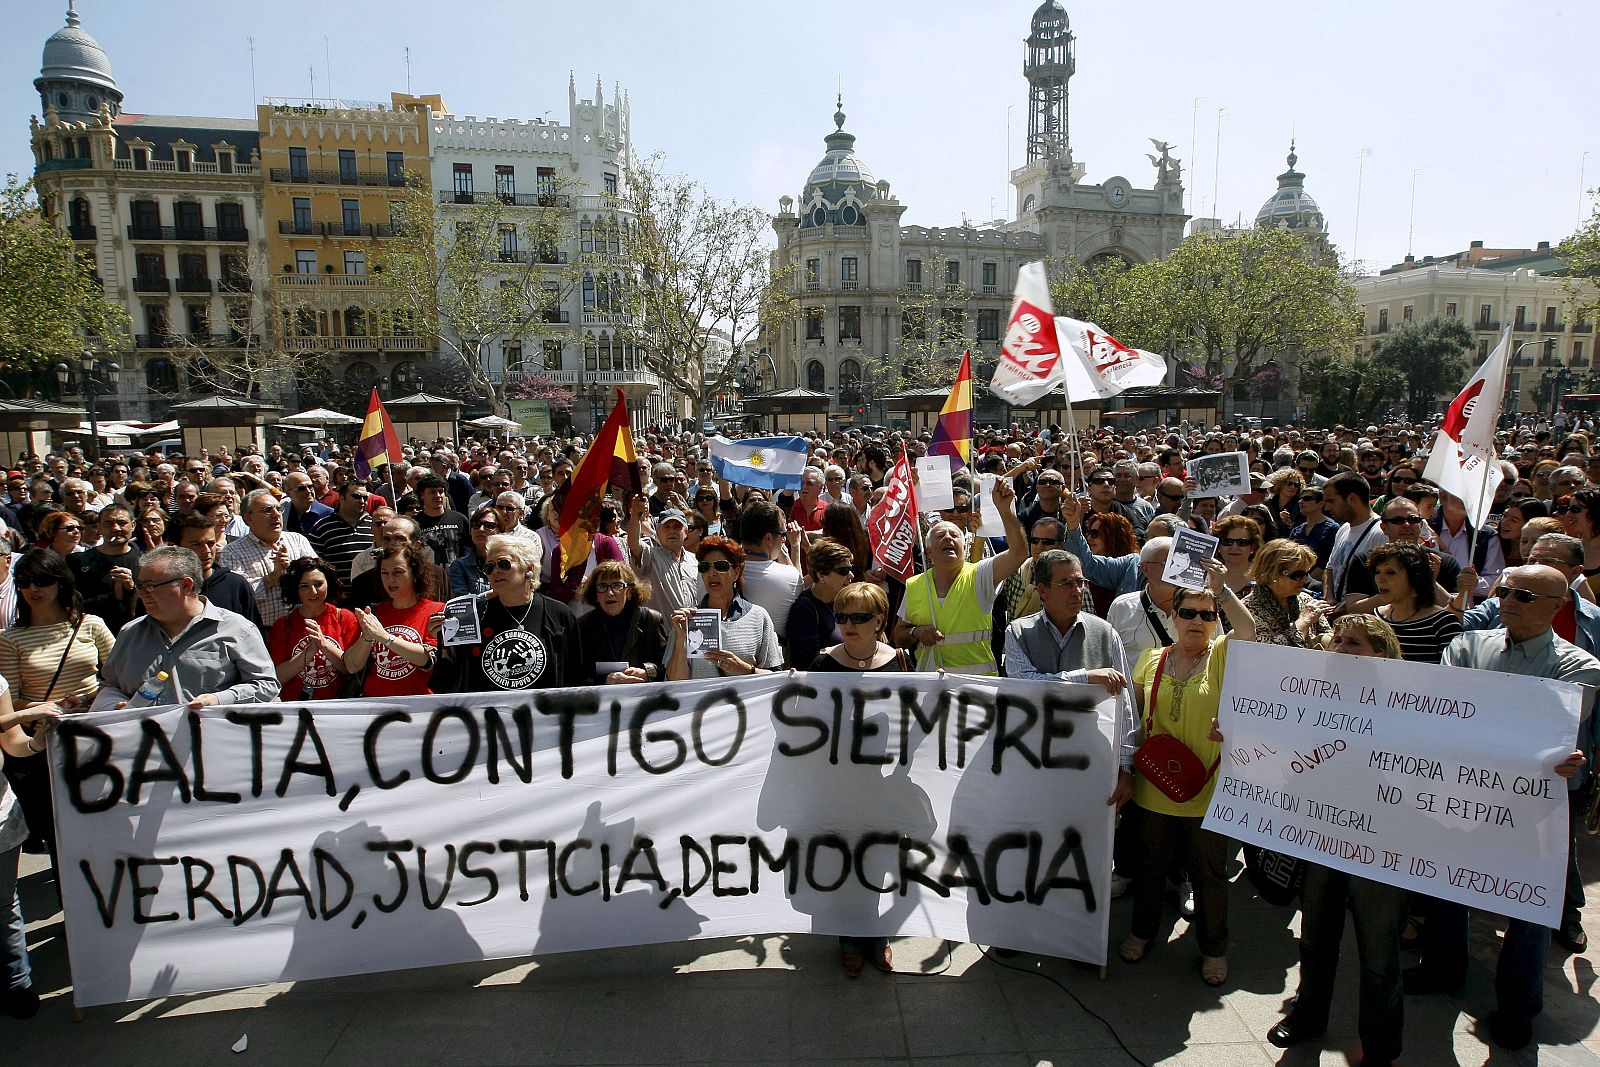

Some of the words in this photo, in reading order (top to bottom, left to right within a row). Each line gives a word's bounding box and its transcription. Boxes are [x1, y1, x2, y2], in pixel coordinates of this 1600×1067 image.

[312, 108, 328, 116] 257
[505, 631, 540, 648] SUBVERSIVO
[486, 667, 510, 687] TAMBIEN
[511, 676, 531, 688] APOYO
[1280, 677, 1341, 701] CONTRA
[1359, 686, 1377, 706] LA
[1386, 690, 1476, 719] IMPUNIDAD
[771, 682, 1098, 775] SIEMPRE
[1232, 697, 1287, 721] VERDAD
[1297, 707, 1306, 724] Y
[1313, 711, 1374, 736] JUSTICIA
[1230, 747, 1252, 767] NO
[1368, 750, 1444, 782] MEMORIA
[1458, 766, 1505, 792] PARA
[1512, 776, 1554, 800] QUE
[1377, 784, 1403, 805] NO
[1416, 792, 1438, 813] SE
[1306, 799, 1378, 835] INTEGRAL
[1212, 804, 1234, 823] NO
[1237, 812, 1250, 829] A
[1256, 816, 1273, 836] LA
[1279, 825, 1376, 866] CONTINUIDAD
[1381, 850, 1402, 873] DE
[1409, 856, 1438, 879] LOS
